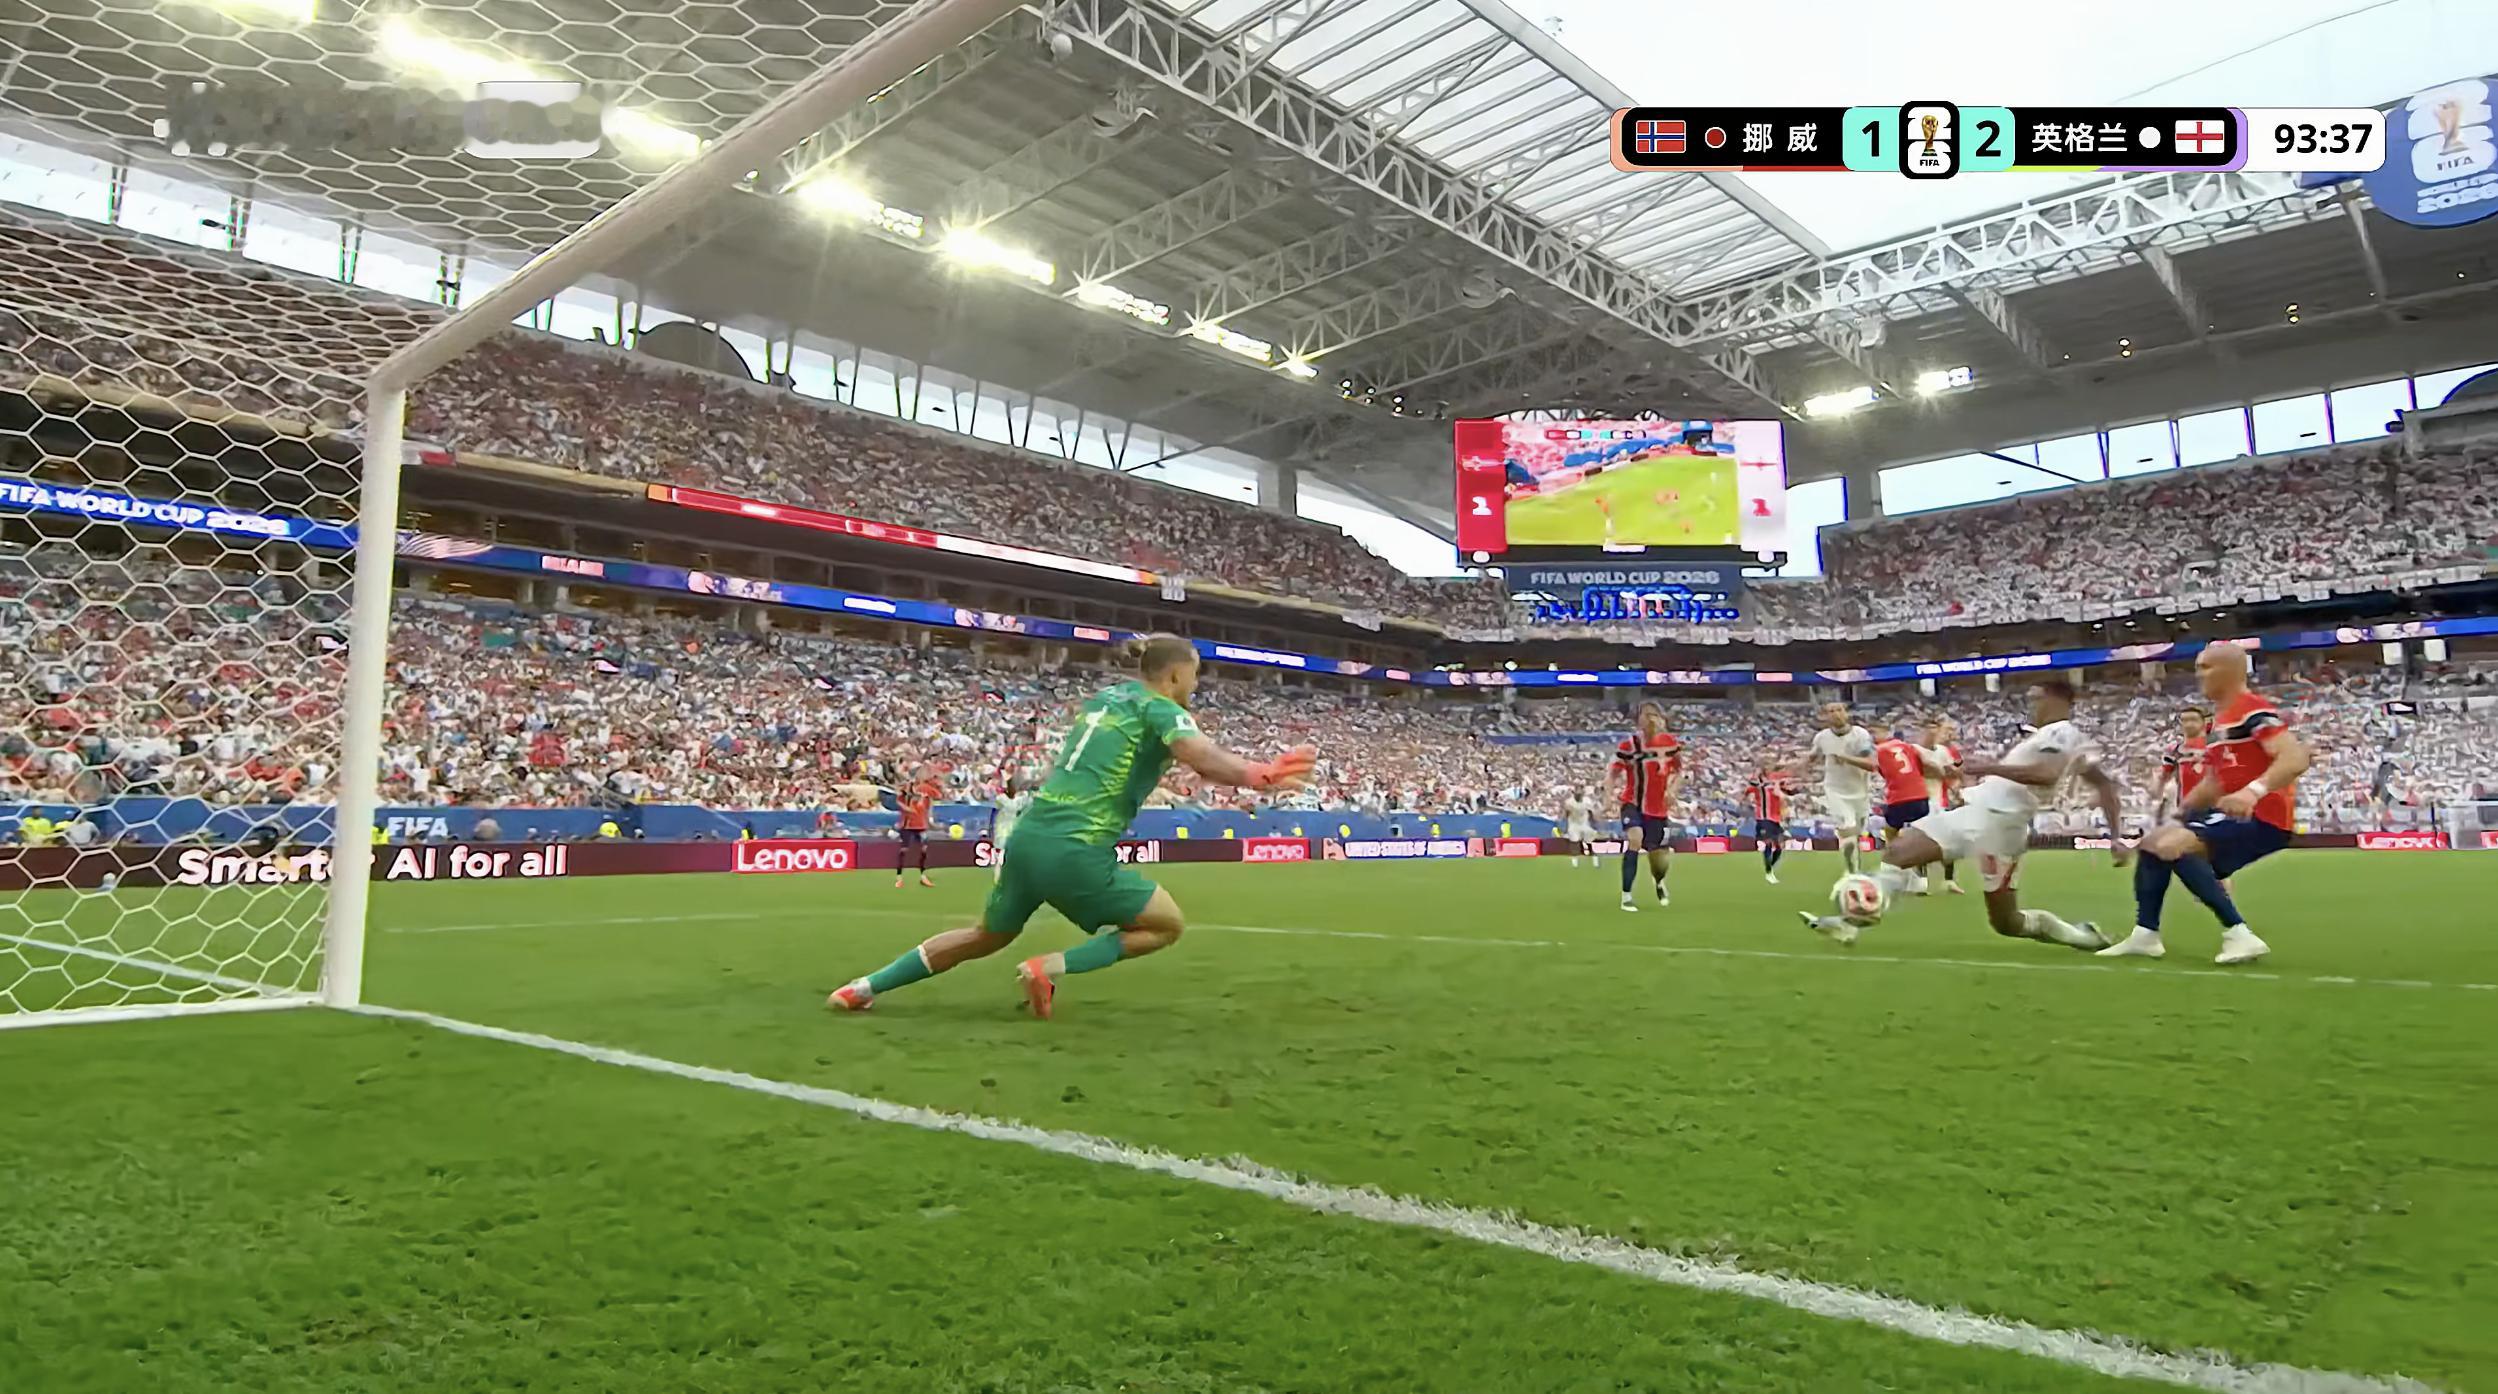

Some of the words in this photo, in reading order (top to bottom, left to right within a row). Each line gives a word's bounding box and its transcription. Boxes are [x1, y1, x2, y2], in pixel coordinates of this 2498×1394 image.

[55, 490, 151, 518] WORLD
[154, 502, 204, 524] CUP
[1531, 572, 1566, 585] FIFA
[1567, 572, 1626, 585] WORLD
[1628, 571, 1661, 585] CUP
[1890, 746, 1912, 774] 3
[387, 816, 448, 837] FIFA
[738, 844, 848, 871] Lenovo
[1137, 840, 1160, 863] all
[1245, 838, 1304, 860] Lenovo
[387, 847, 437, 880] AI
[449, 844, 511, 878] for
[520, 844, 569, 876] all
